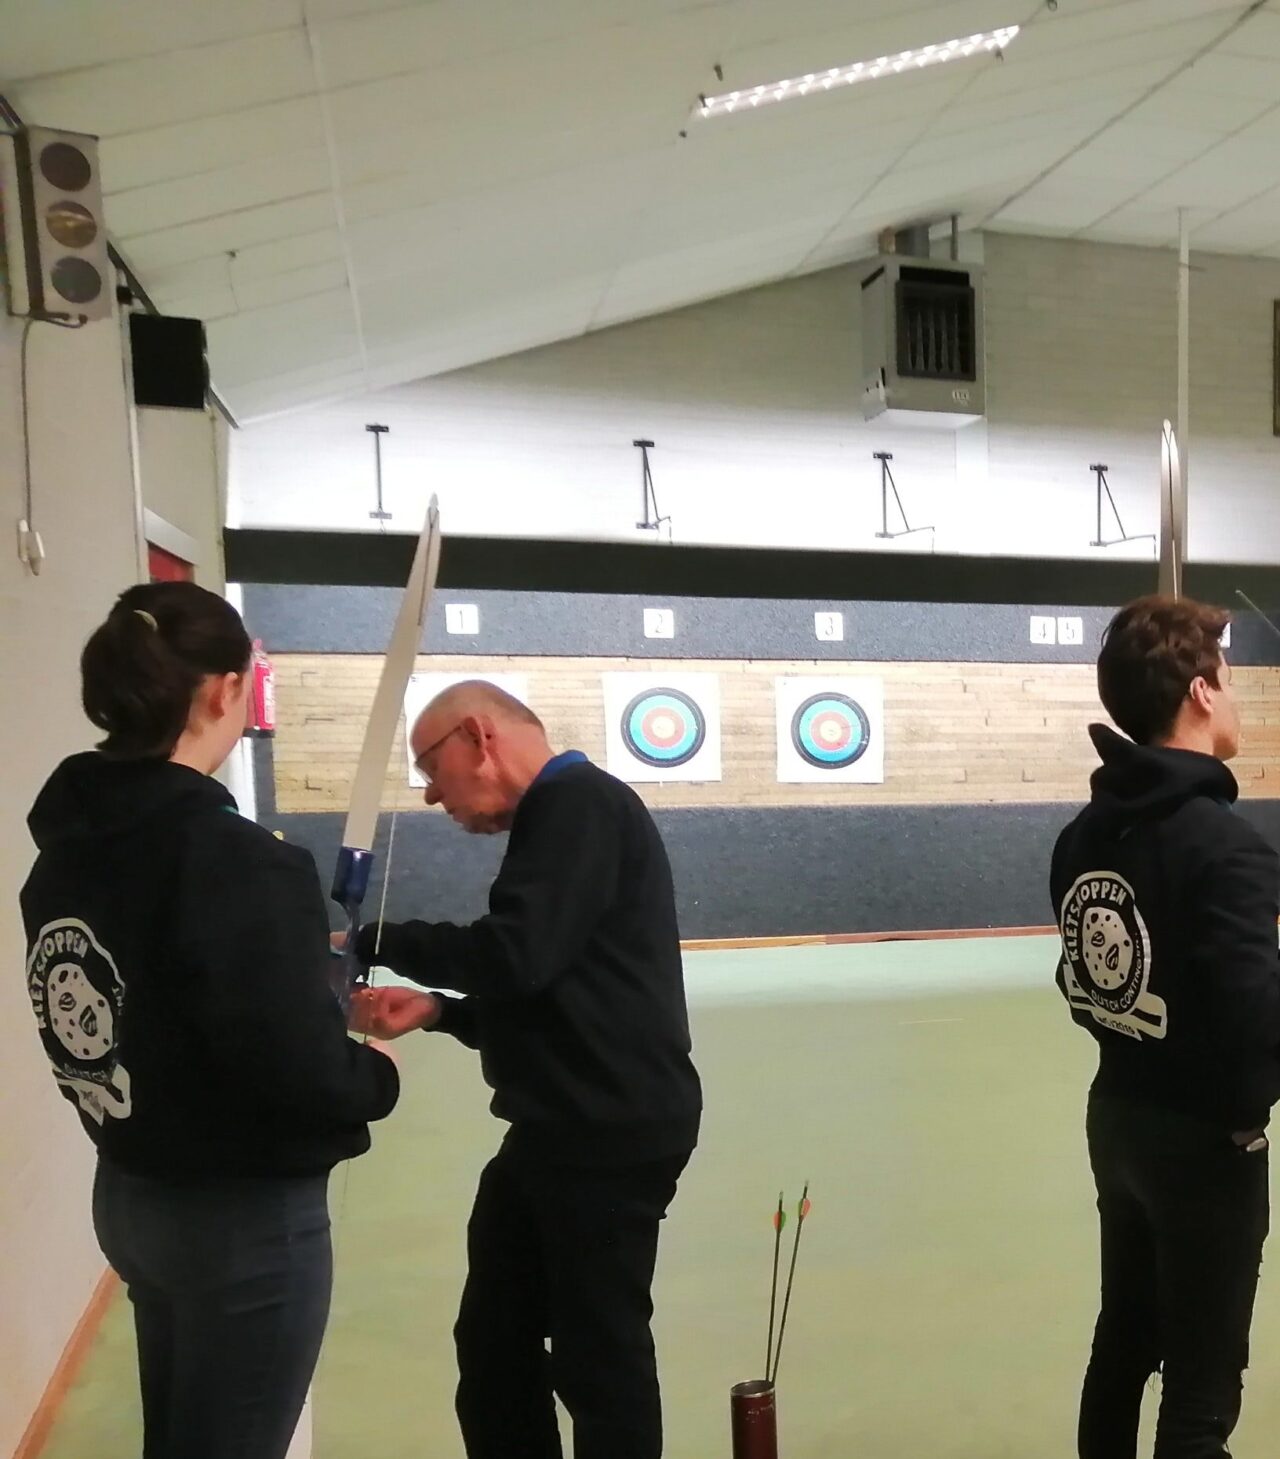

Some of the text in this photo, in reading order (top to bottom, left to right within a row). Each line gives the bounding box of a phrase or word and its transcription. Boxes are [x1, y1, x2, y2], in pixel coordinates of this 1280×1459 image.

[824, 615, 834, 637] 3
[1066, 881, 1127, 962] KLETSKOPPEN
[1091, 989, 1120, 1012] DUTCH
